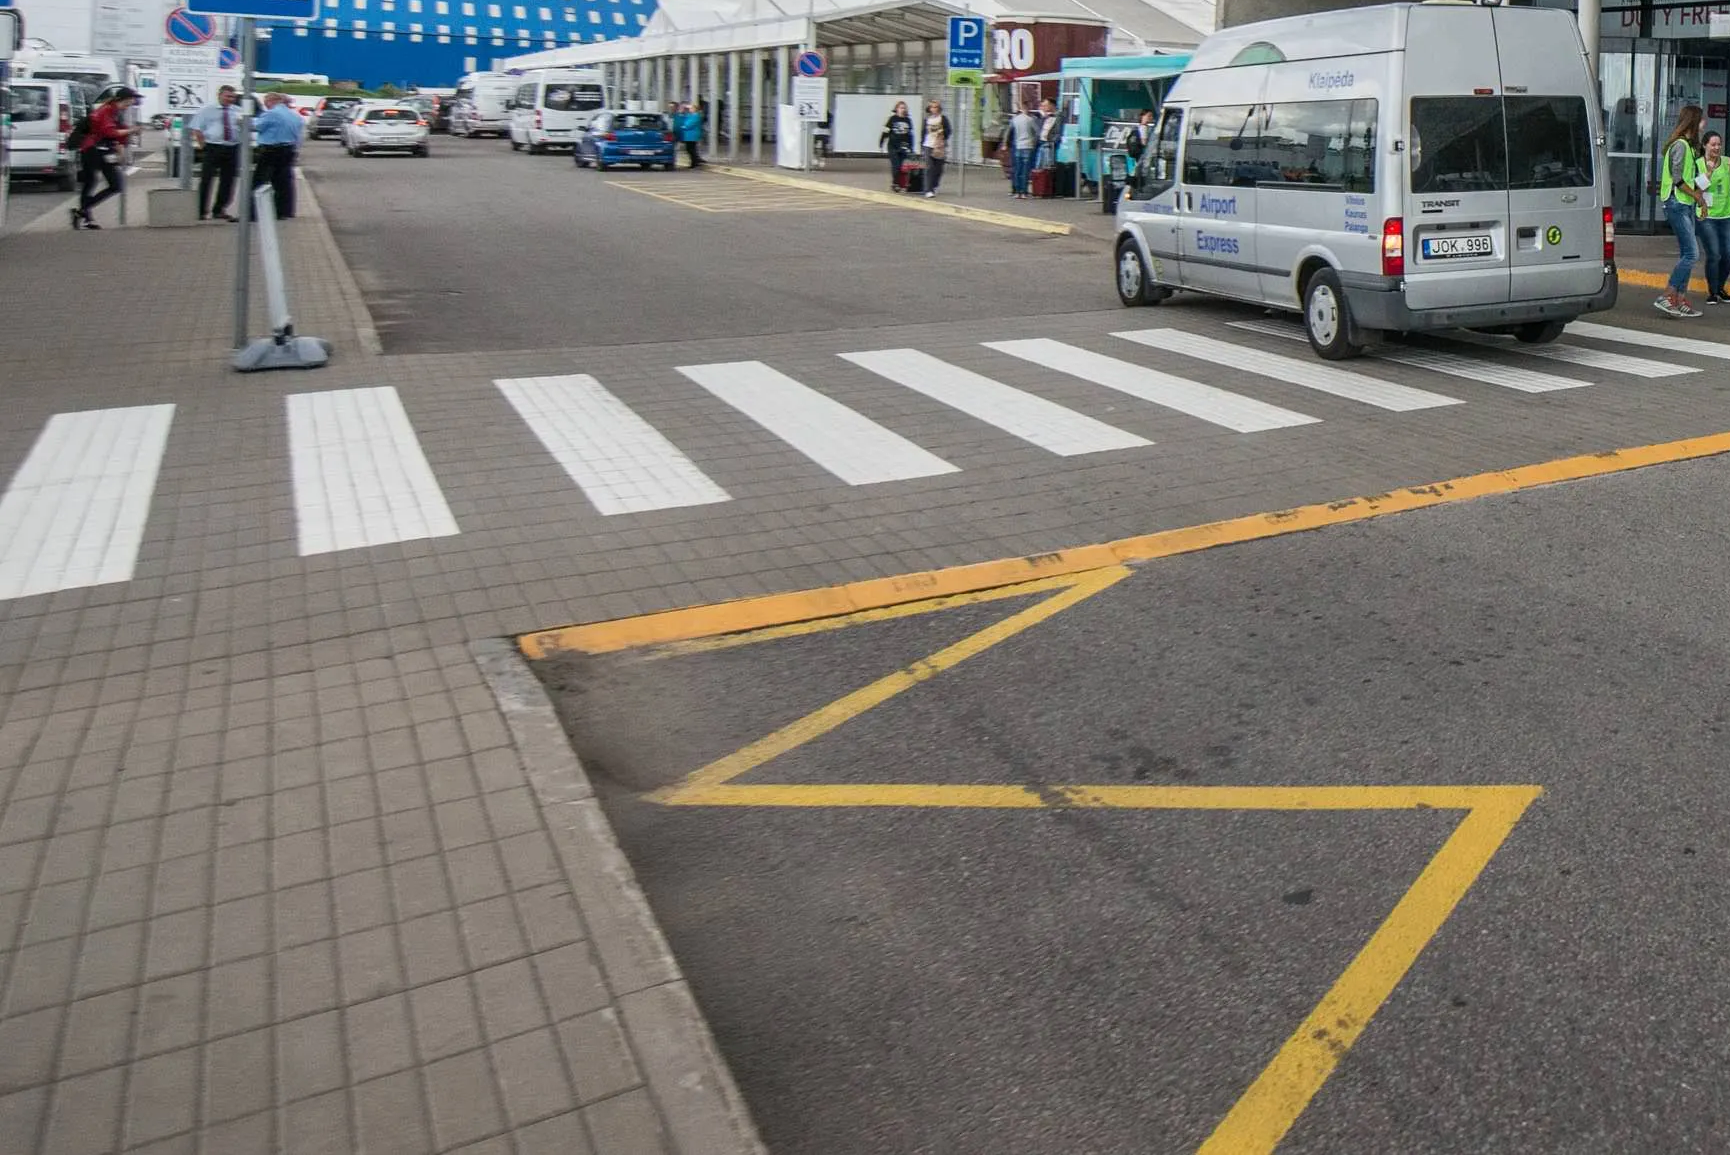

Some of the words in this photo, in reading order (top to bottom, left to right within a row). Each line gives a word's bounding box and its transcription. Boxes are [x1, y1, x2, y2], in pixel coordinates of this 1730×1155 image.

[959, 20, 979, 46] P
[1200, 193, 1237, 218] Airport
[1420, 199, 1461, 209] TRANSIT
[1196, 229, 1240, 256] Express
[1432, 240, 1462, 254] JOK
[1466, 237, 1489, 251] 996
